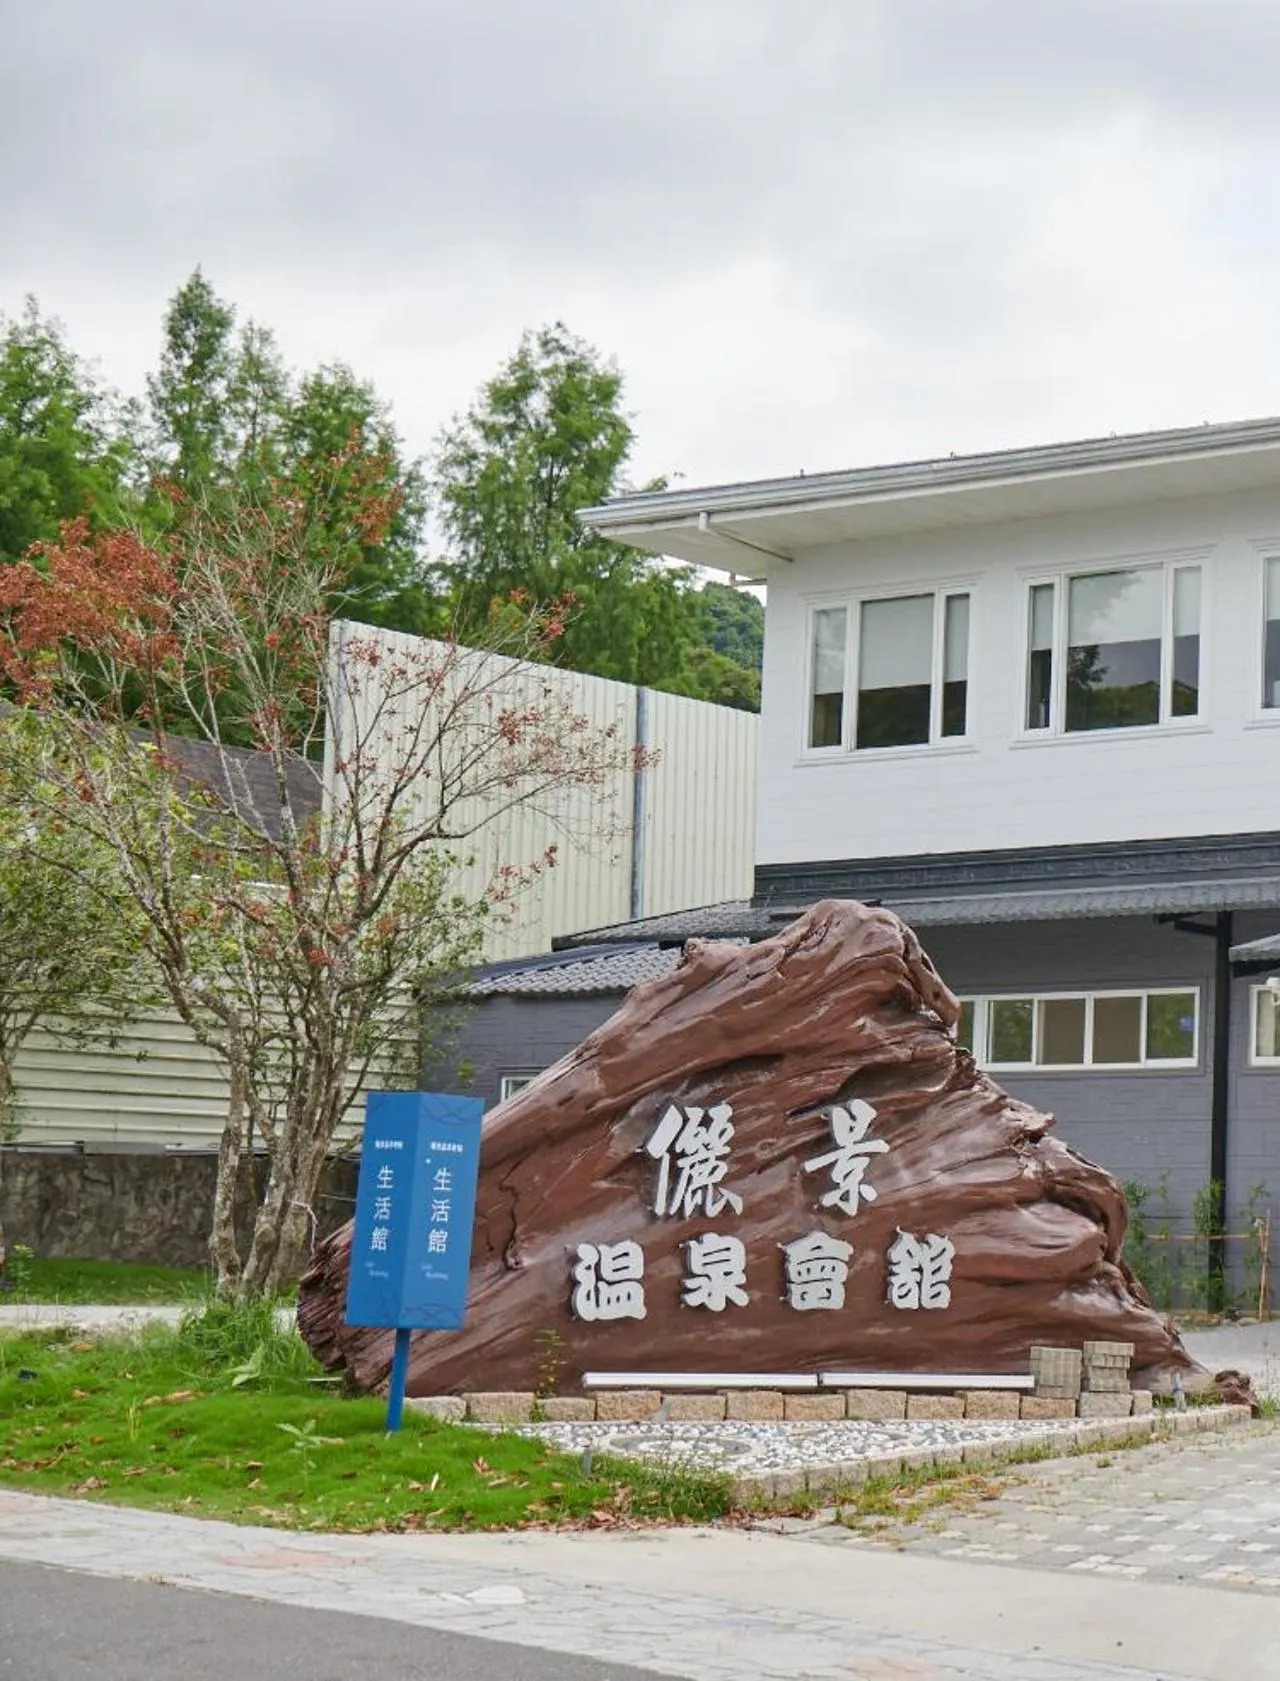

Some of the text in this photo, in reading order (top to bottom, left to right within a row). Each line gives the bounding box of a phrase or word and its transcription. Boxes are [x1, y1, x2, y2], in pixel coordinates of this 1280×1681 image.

[646, 1100, 889, 1217] 儷景
[370, 1165, 394, 1251] 生活館
[428, 1167, 452, 1253] 生活館
